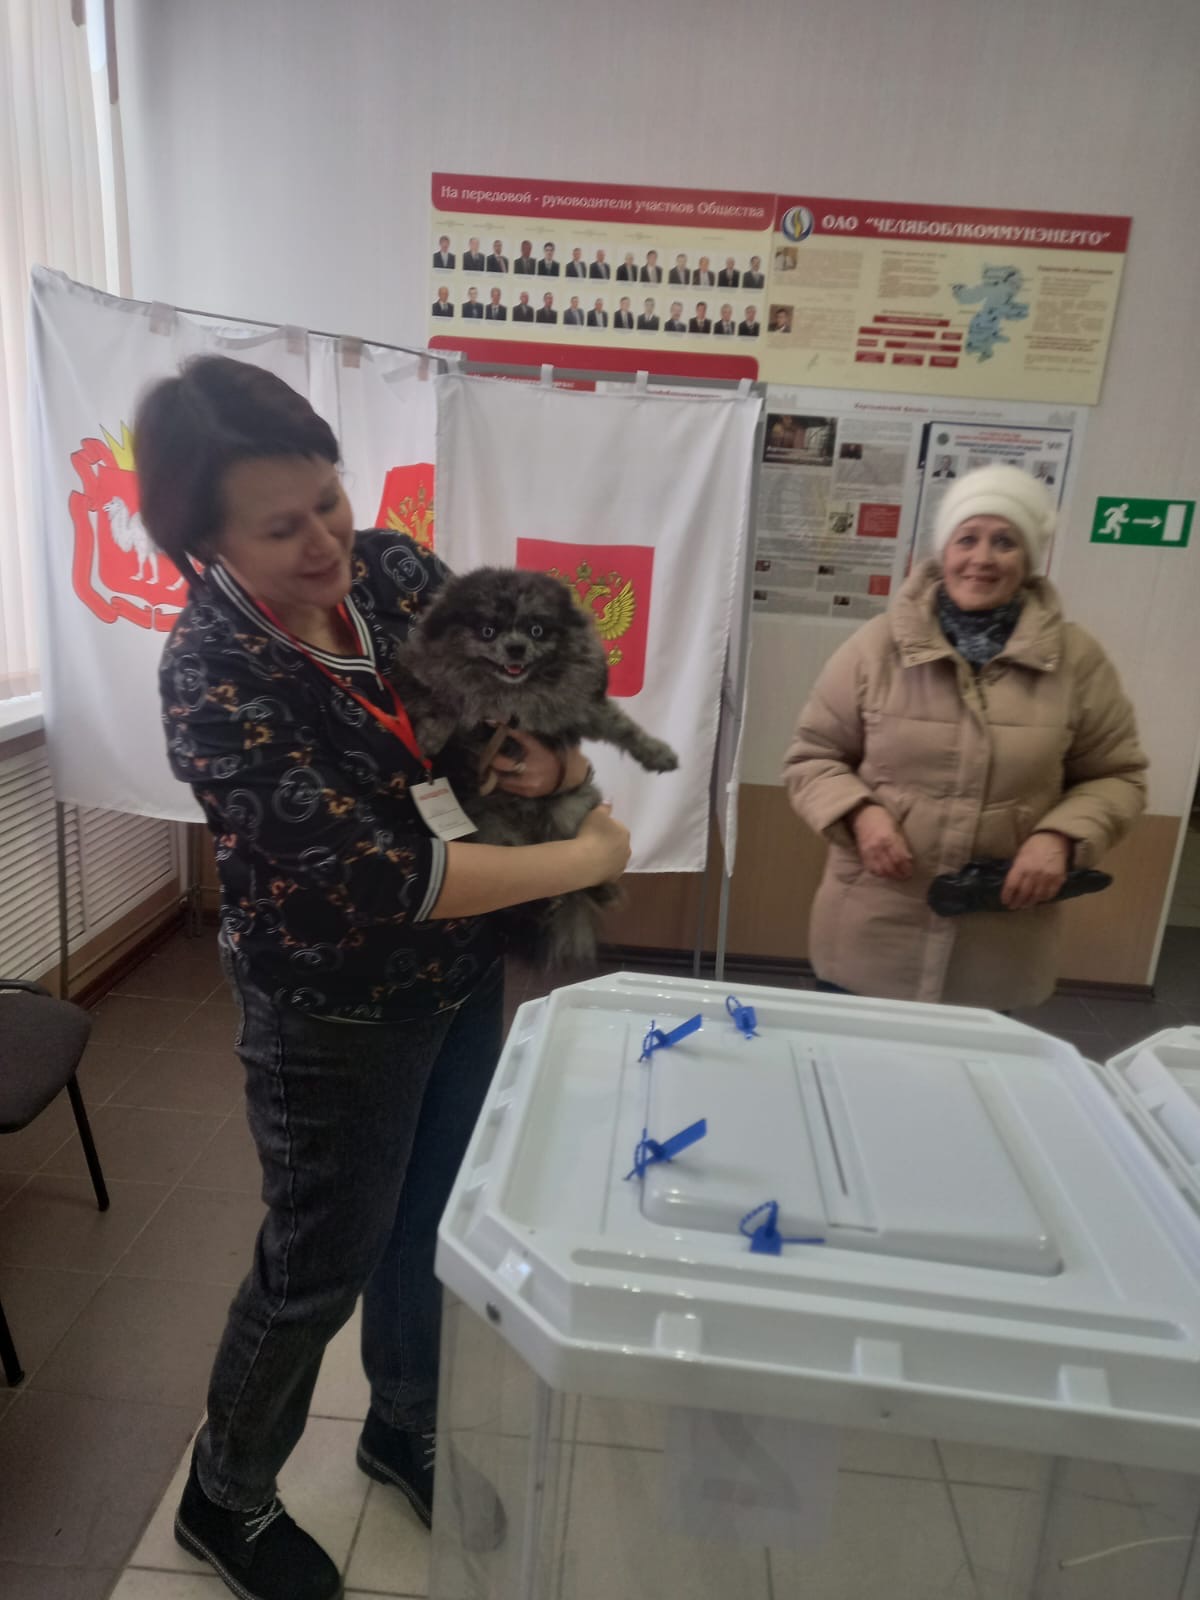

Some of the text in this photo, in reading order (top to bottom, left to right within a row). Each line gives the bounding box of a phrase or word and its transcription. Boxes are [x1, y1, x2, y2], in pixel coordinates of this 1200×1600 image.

[441, 186, 458, 199] На
[461, 187, 531, 204] передовой
[541, 194, 632, 211] руководители
[635, 199, 694, 214] участков
[697, 201, 765, 217] Общества
[821, 214, 859, 232] ОАО
